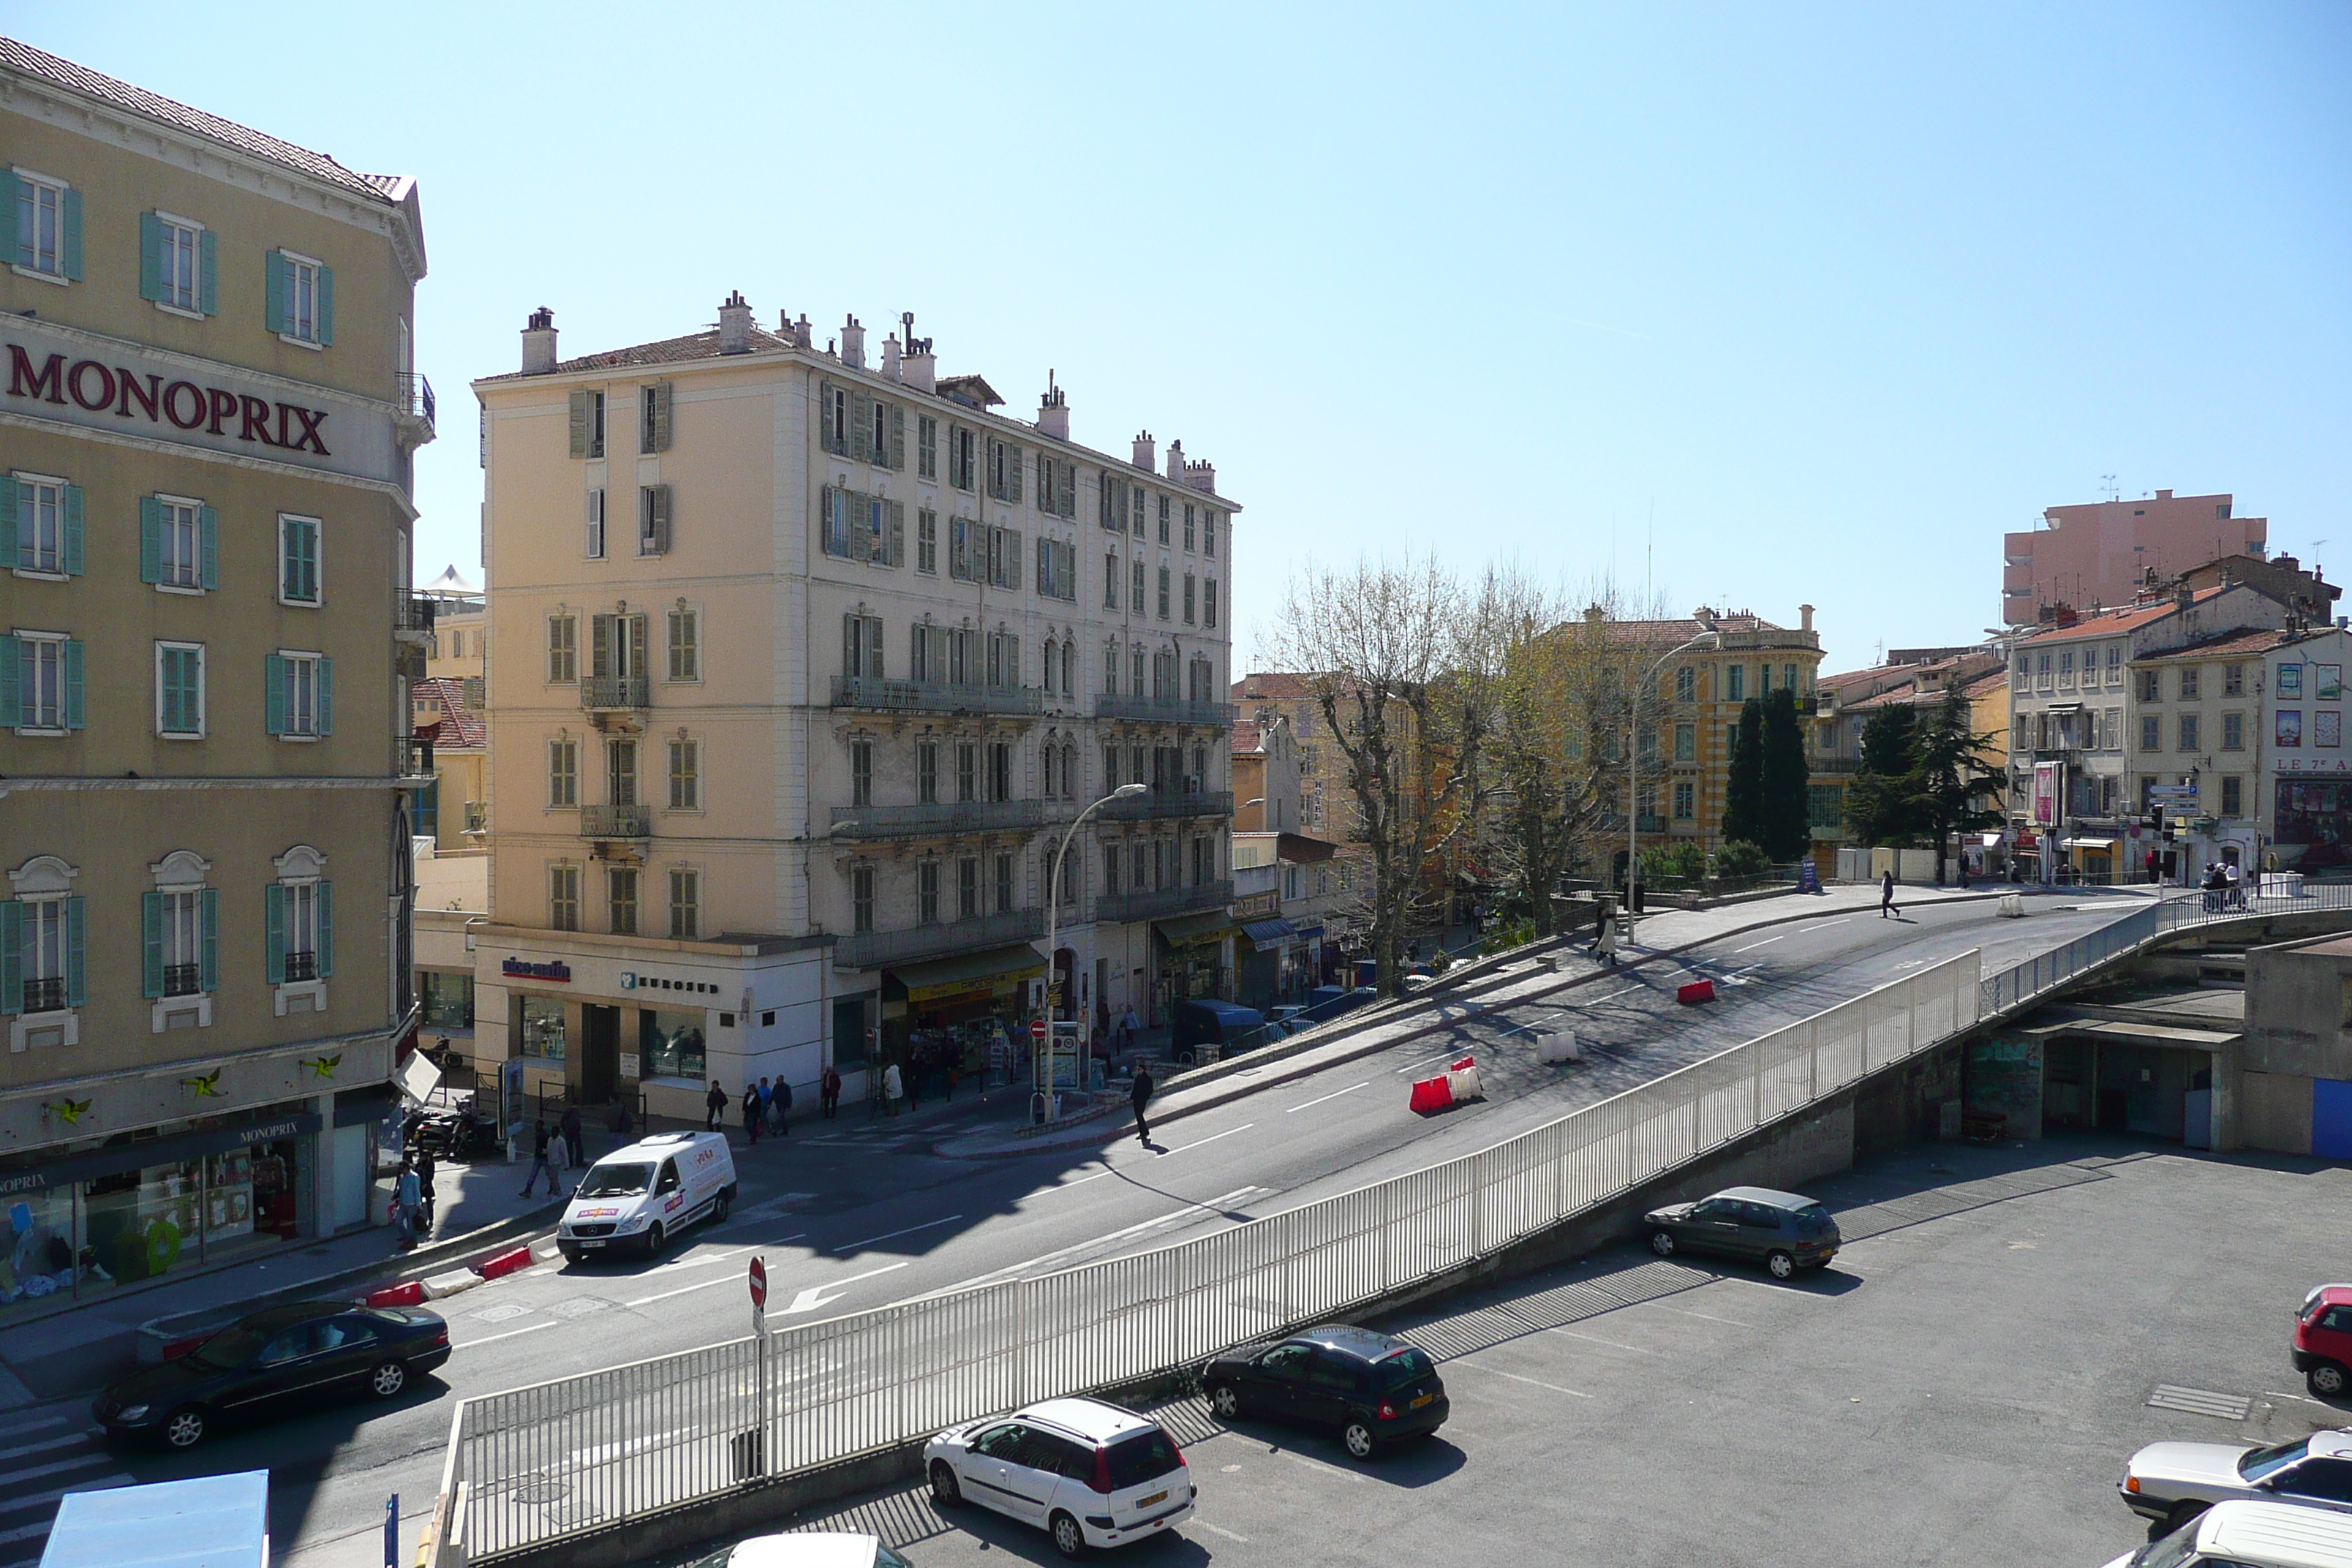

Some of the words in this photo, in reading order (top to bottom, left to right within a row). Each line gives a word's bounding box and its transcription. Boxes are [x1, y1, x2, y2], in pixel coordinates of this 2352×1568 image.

[7, 344, 331, 456] MONOPRIX
[2277, 759, 2301, 769] LE
[2336, 760, 2352, 770] A
[639, 978, 718, 993] EUROSUD
[241, 1121, 298, 1143] MONOPRIX
